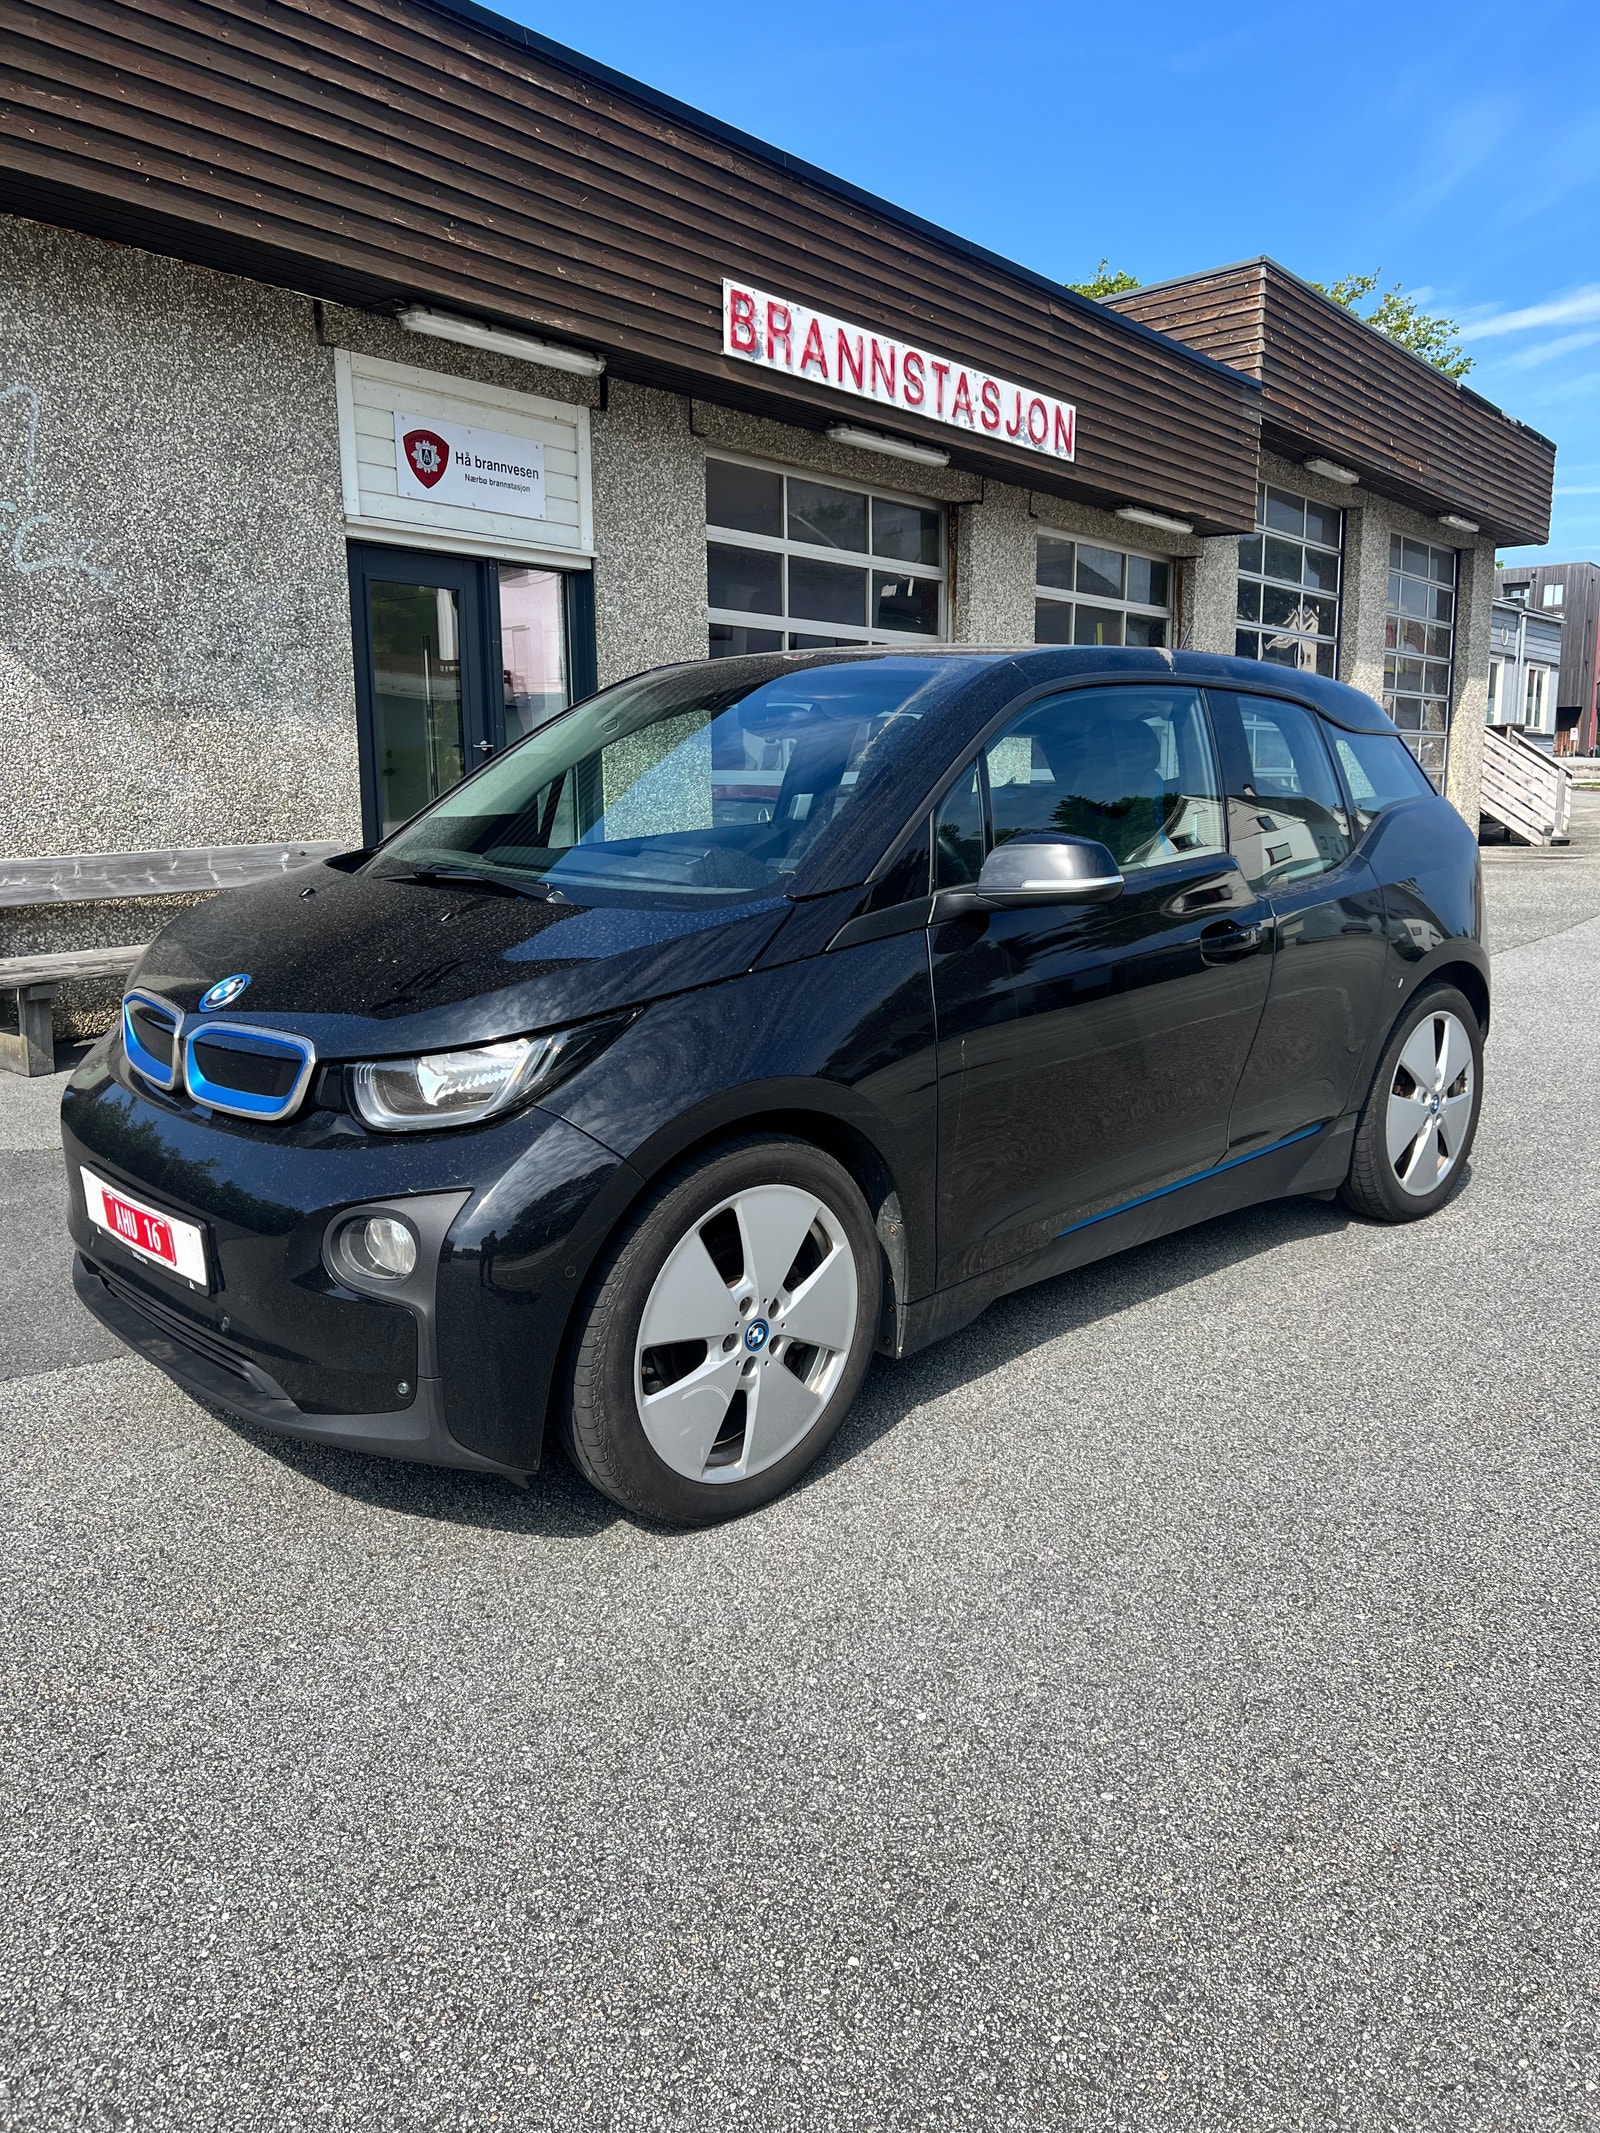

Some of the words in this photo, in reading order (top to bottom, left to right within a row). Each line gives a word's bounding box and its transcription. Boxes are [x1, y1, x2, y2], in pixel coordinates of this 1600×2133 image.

[729, 288, 1074, 455] BRANNSTASJON
[455, 451, 471, 467] Hå
[475, 455, 539, 480] brannvesen
[464, 473, 488, 485] Nærbø
[489, 477, 530, 493] brannstasjon
[115, 1203, 138, 1240] AHU
[143, 1219, 161, 1251] 16
